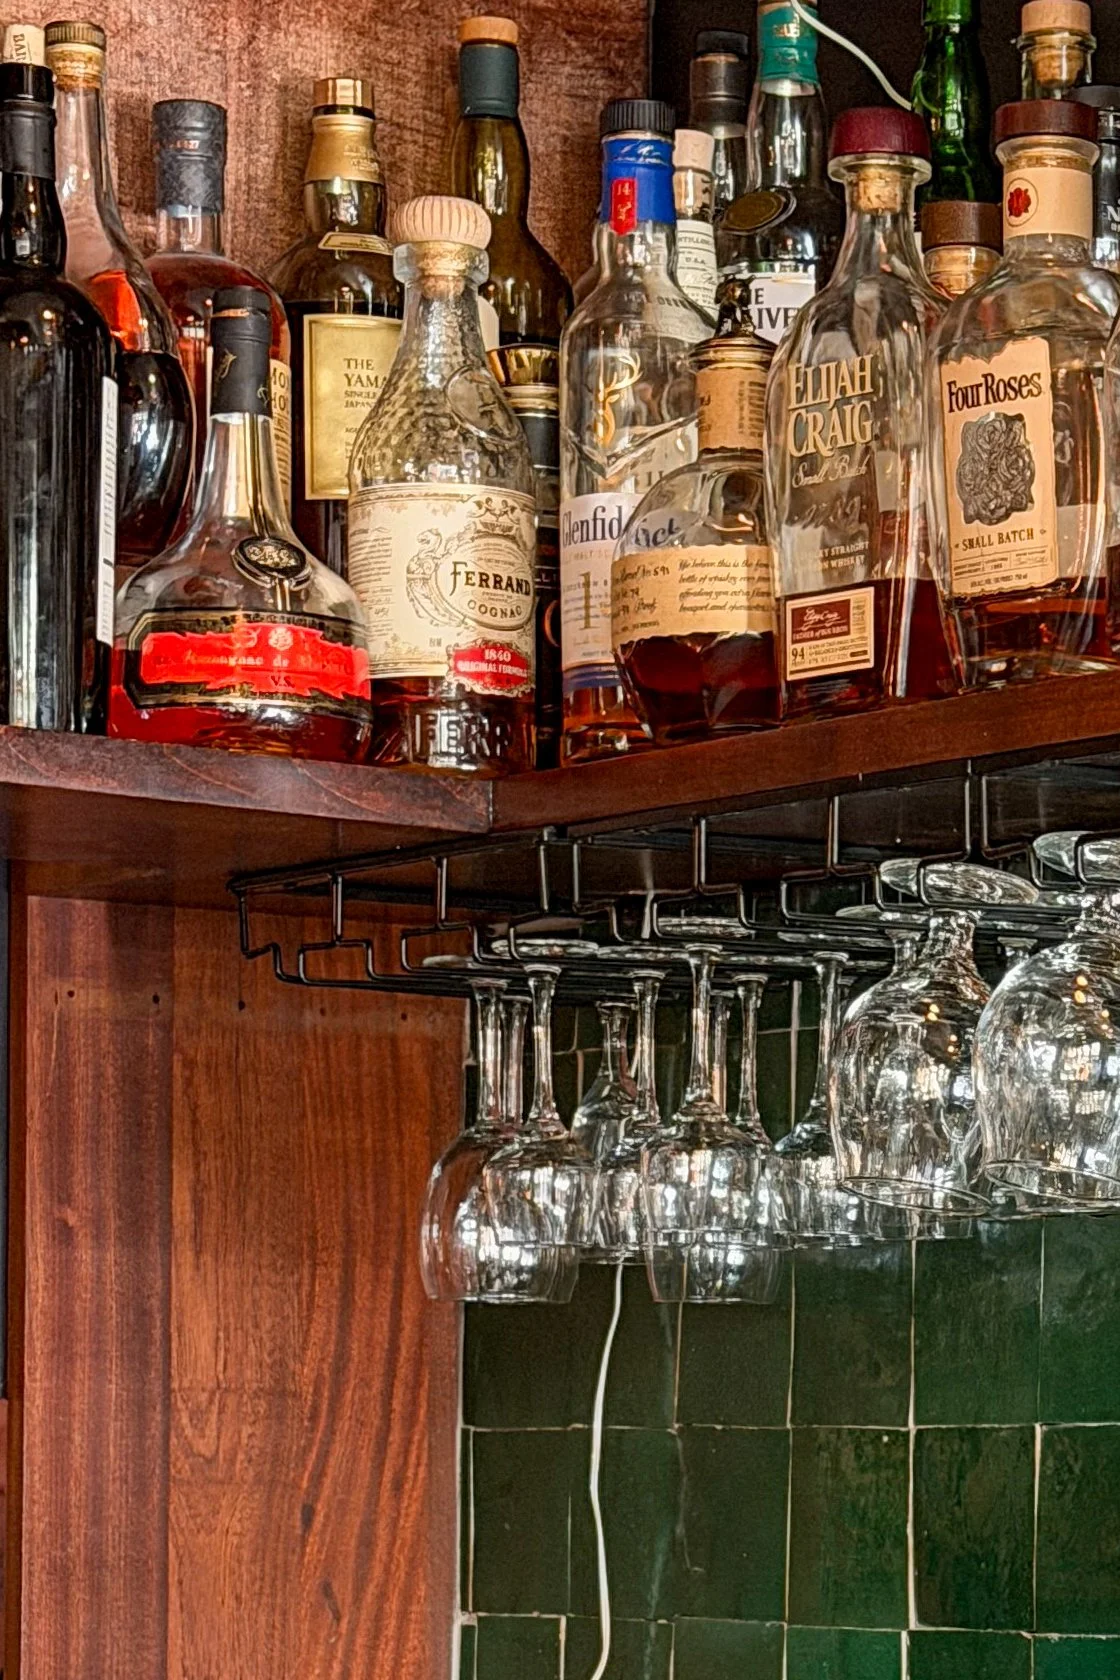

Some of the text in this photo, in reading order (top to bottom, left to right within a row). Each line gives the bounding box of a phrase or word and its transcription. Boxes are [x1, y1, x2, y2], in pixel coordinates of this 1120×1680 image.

[617, 184, 632, 196] 14
[344, 358, 374, 370] THE
[788, 354, 874, 410] ELIJAH
[947, 371, 1042, 413] Four Roses
[787, 400, 874, 458] CRAIG
[962, 528, 1034, 551] SMALL BATCH
[450, 561, 532, 597] FERRAND
[467, 599, 522, 620] COGNAC
[791, 647, 805, 660] 94
